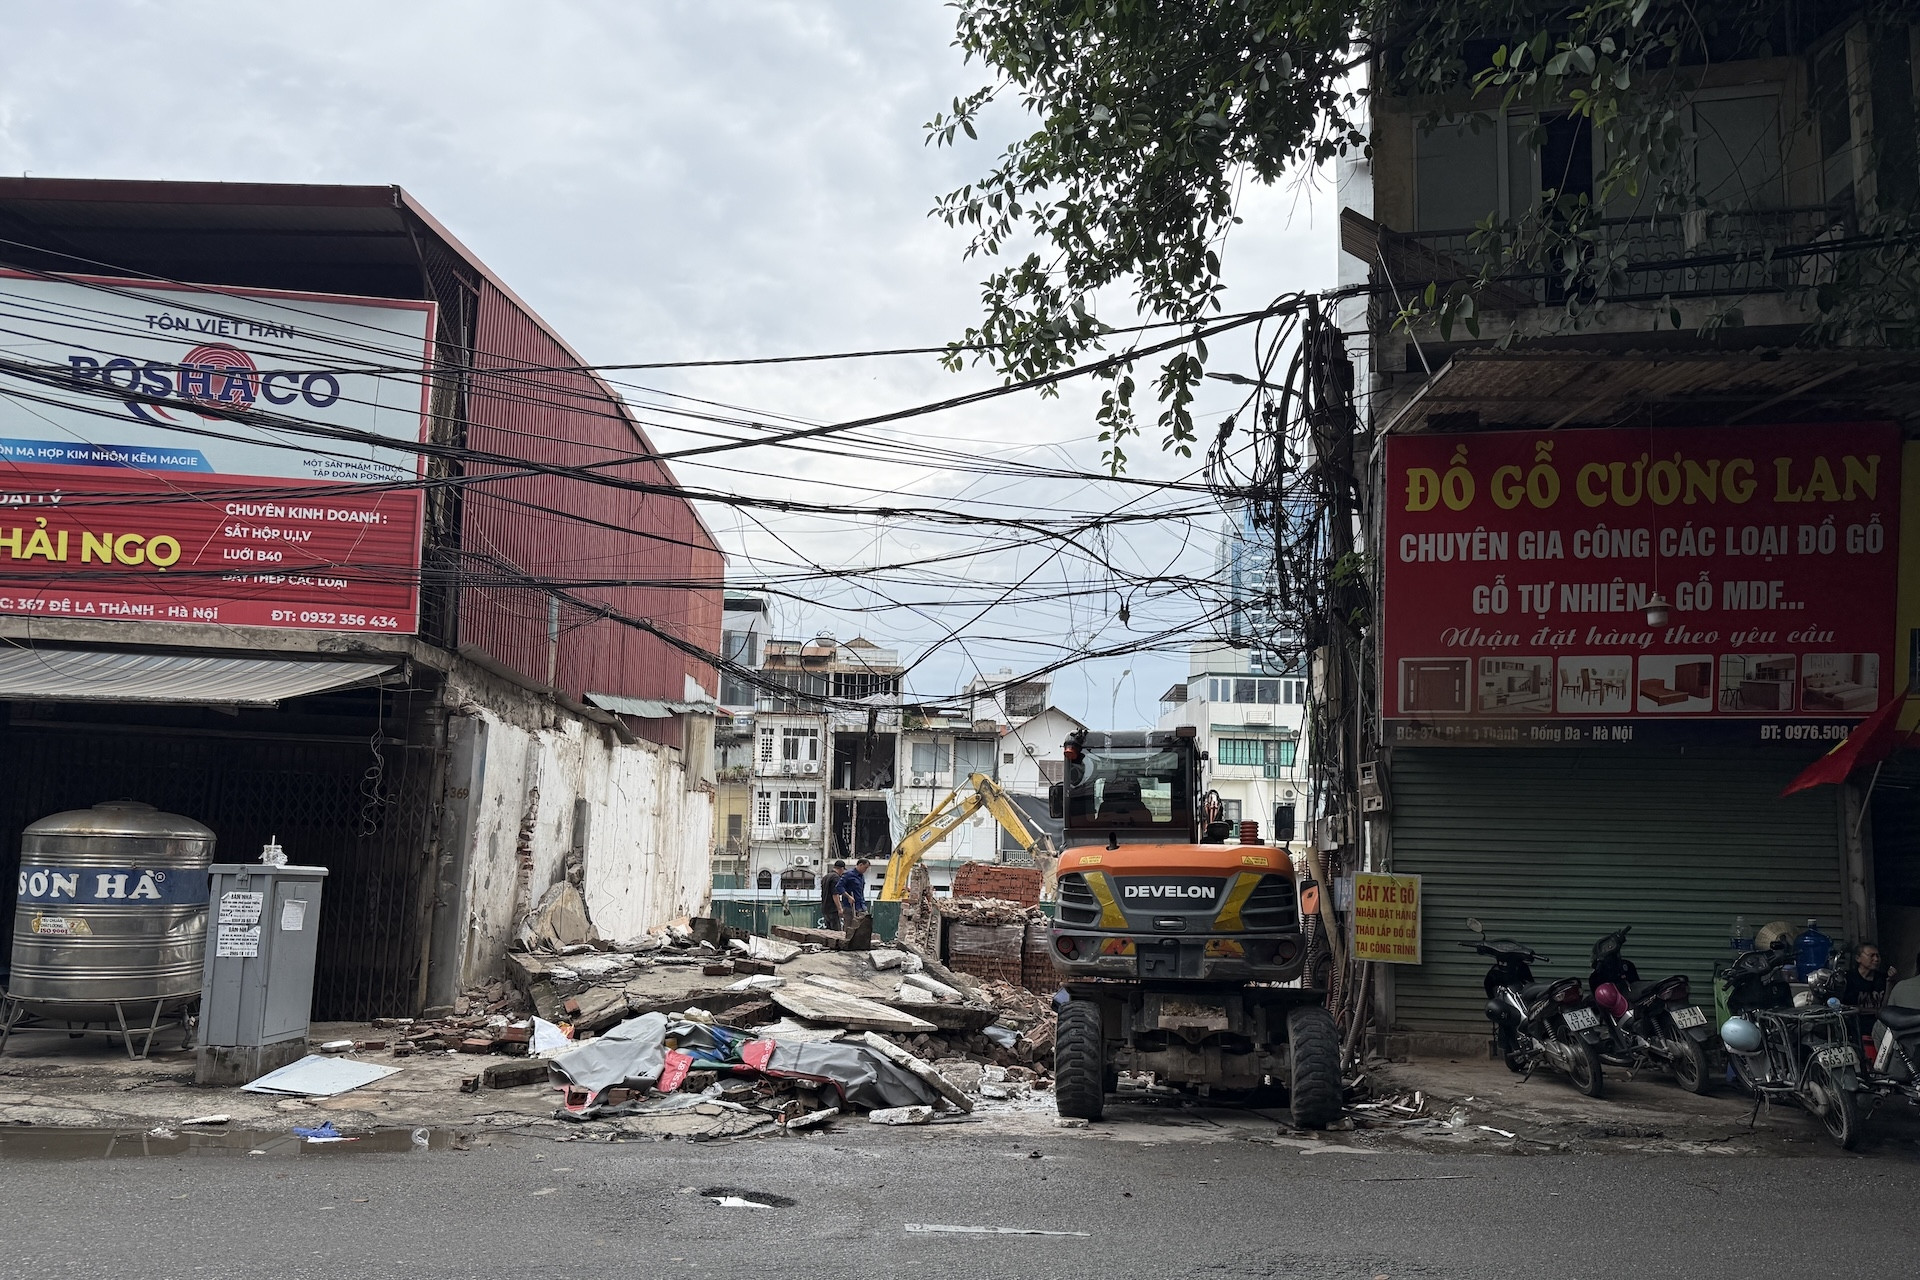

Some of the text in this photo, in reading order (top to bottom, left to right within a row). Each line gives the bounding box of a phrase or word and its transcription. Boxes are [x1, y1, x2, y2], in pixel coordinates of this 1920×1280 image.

[145, 312, 294, 340] TÔN VIỆT HÀN
[68, 355, 340, 409] POSHACO
[17, 448, 36, 459] MẠ
[38, 449, 64, 458] HỢP
[67, 450, 89, 460] KIM
[92, 450, 129, 462] NHÔM
[131, 451, 157, 464] KẼM
[160, 455, 198, 466] MAGIE
[360, 472, 403, 482] POSHACO
[1405, 440, 1881, 512] ĐỒ GỖ CƯƠNG LAN
[225, 503, 284, 518] CHUYÊN
[288, 507, 324, 521] KINH
[327, 510, 380, 524] DOANH
[224, 523, 312, 543] SẮT HỘP U,I,V
[1399, 512, 1884, 562] CHUYÊN GIA CÔNG CÁC LOẠI ĐỒ GỖ
[81, 530, 182, 572] NGỌ
[257, 551, 283, 563] B40
[318, 576, 348, 590] LOẠI
[1473, 574, 1509, 615] GỖ
[1518, 580, 1555, 619] TỰ
[1560, 577, 1647, 612] NHIÊN
[1676, 571, 1713, 611] GỖ
[1723, 580, 1805, 610] MDF...
[17, 598, 45, 611] 367
[48, 598, 71, 612] ĐÊ
[75, 602, 96, 613] LA
[99, 600, 154, 616] THÀNH
[168, 606, 188, 618] Hà
[193, 606, 218, 622] Nội
[271, 609, 398, 628] ĐT: 0932 356 434
[1440, 622, 1836, 651] Nhận đặt hàng theo yêu cầu
[1482, 725, 1519, 741] Thành
[1530, 724, 1561, 742] Đống
[1565, 727, 1580, 740] Đa
[1593, 726, 1609, 740] Hà
[1612, 725, 1632, 743] Nội
[1760, 725, 1781, 740] ĐT:
[450, 787, 469, 799] 369
[18, 869, 162, 900] SƠN HÀ
[1124, 885, 1216, 899] DEVELON
[1358, 879, 1379, 902] CẮT
[1400, 881, 1414, 904] GỖ
[1356, 906, 1377, 920] NHẬN
[1379, 907, 1394, 921] ĐẶT
[1356, 942, 1368, 954] TẠI
[1571, 1017, 1597, 1029] 171.58
